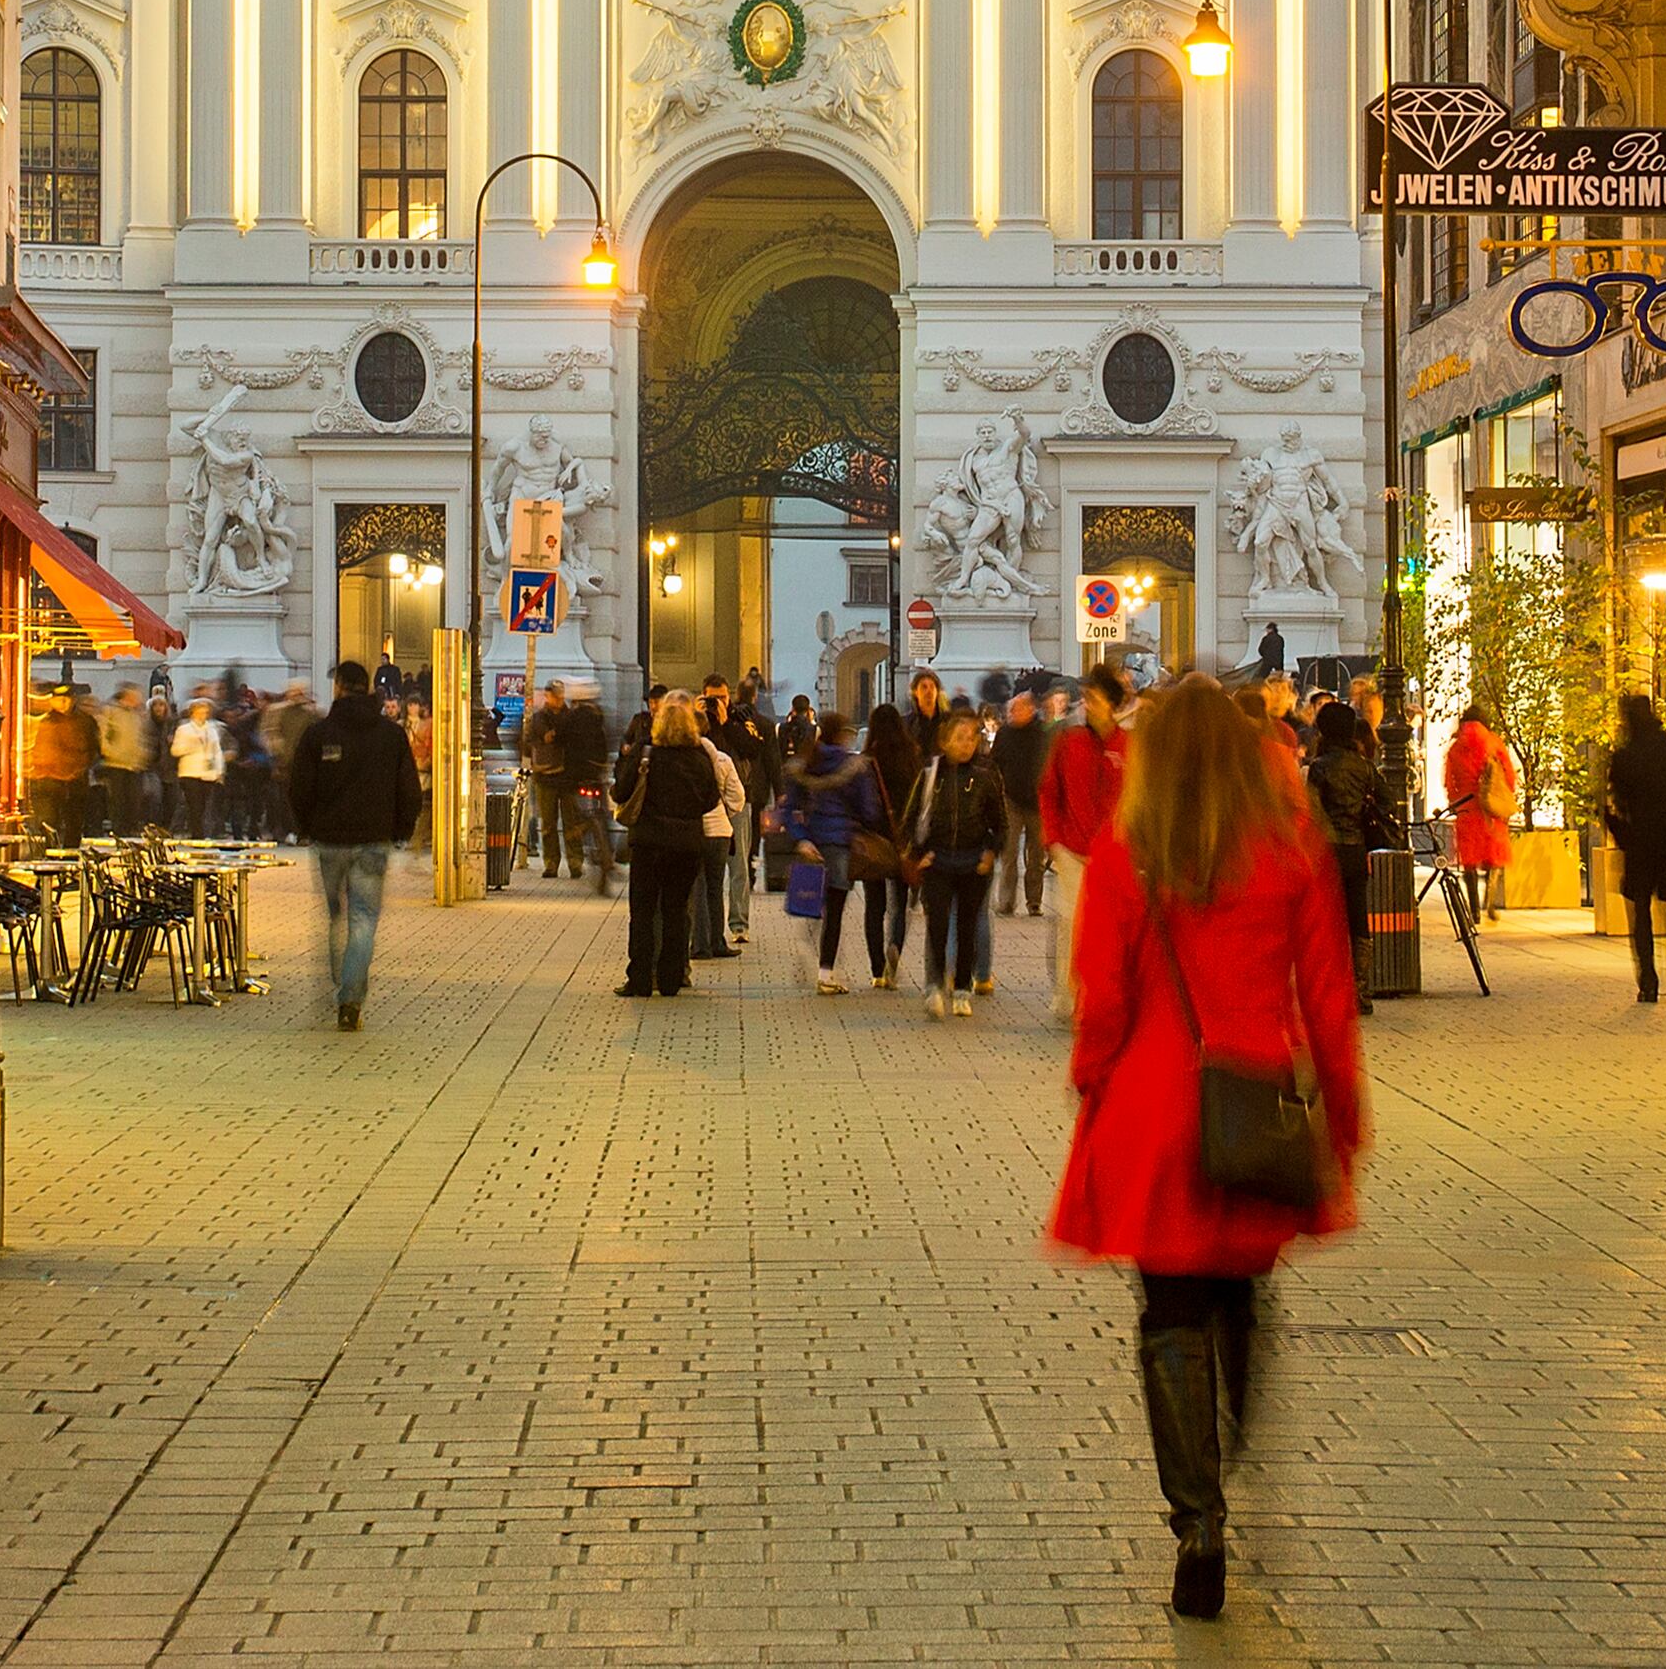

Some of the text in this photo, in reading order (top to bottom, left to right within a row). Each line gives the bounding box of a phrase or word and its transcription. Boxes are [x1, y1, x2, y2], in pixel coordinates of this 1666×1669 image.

[1478, 129, 1557, 172] Kiss
[1567, 145, 1596, 171] &
[1501, 499, 1535, 520] Loro
[1085, 622, 1118, 639] Zone
